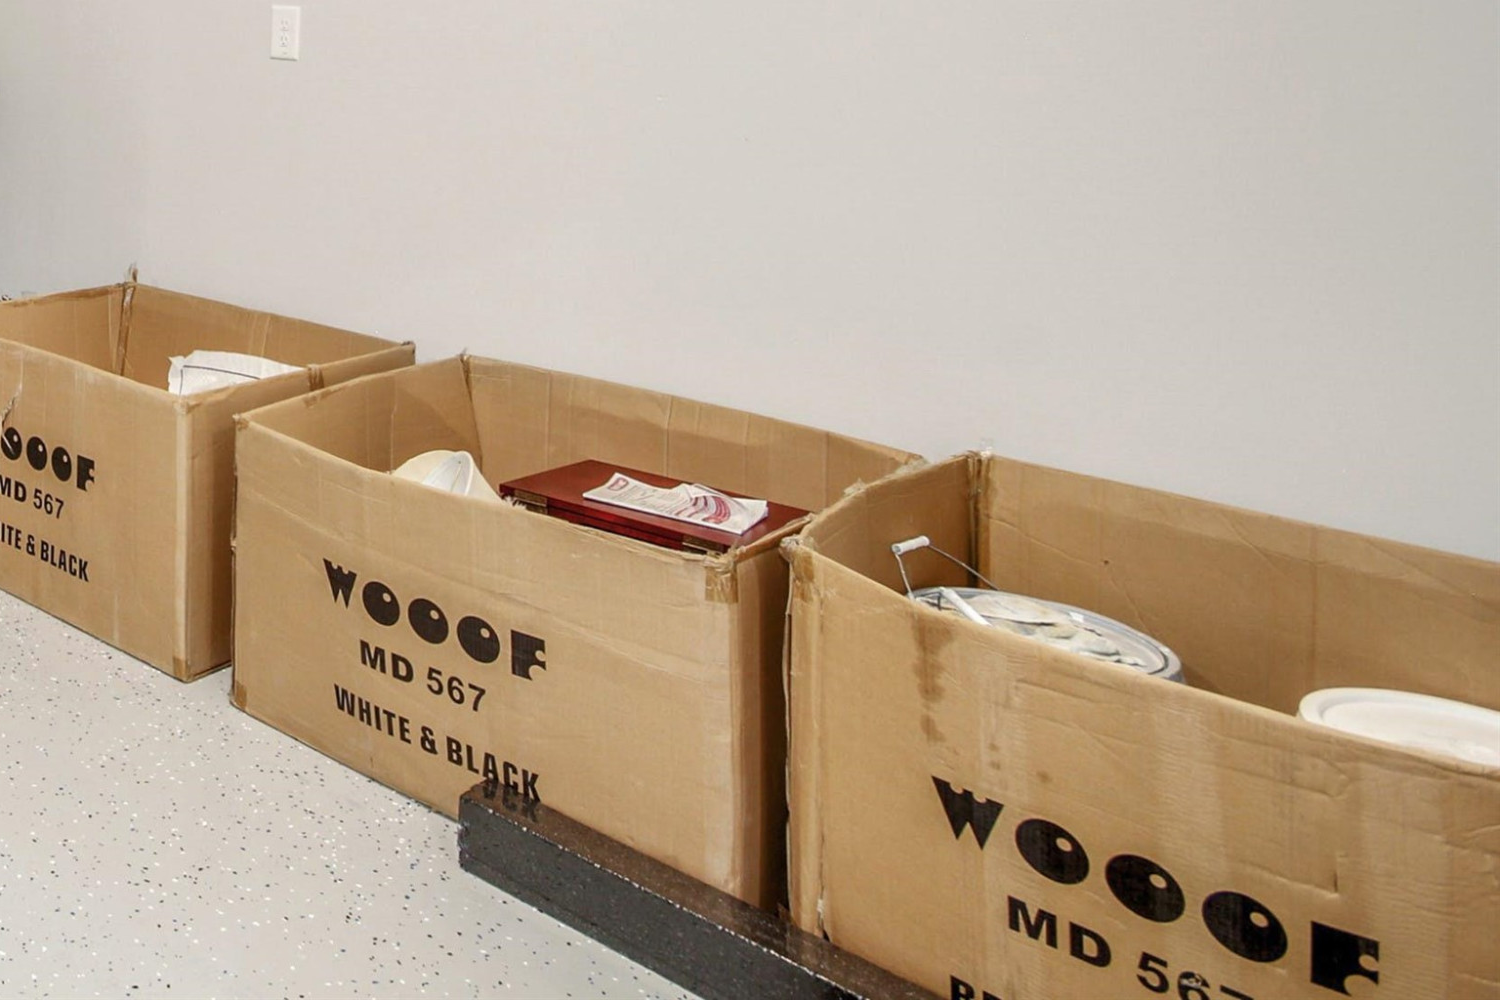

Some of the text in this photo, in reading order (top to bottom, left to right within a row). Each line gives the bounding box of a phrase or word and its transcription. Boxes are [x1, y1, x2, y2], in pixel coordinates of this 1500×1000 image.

[33, 488, 64, 519] 567
[26, 533, 36, 557] &
[41, 540, 89, 583] BLACK
[360, 640, 487, 712] MD 567
[334, 684, 541, 803] WHITE & BLACK
[1007, 895, 1112, 967] MD
